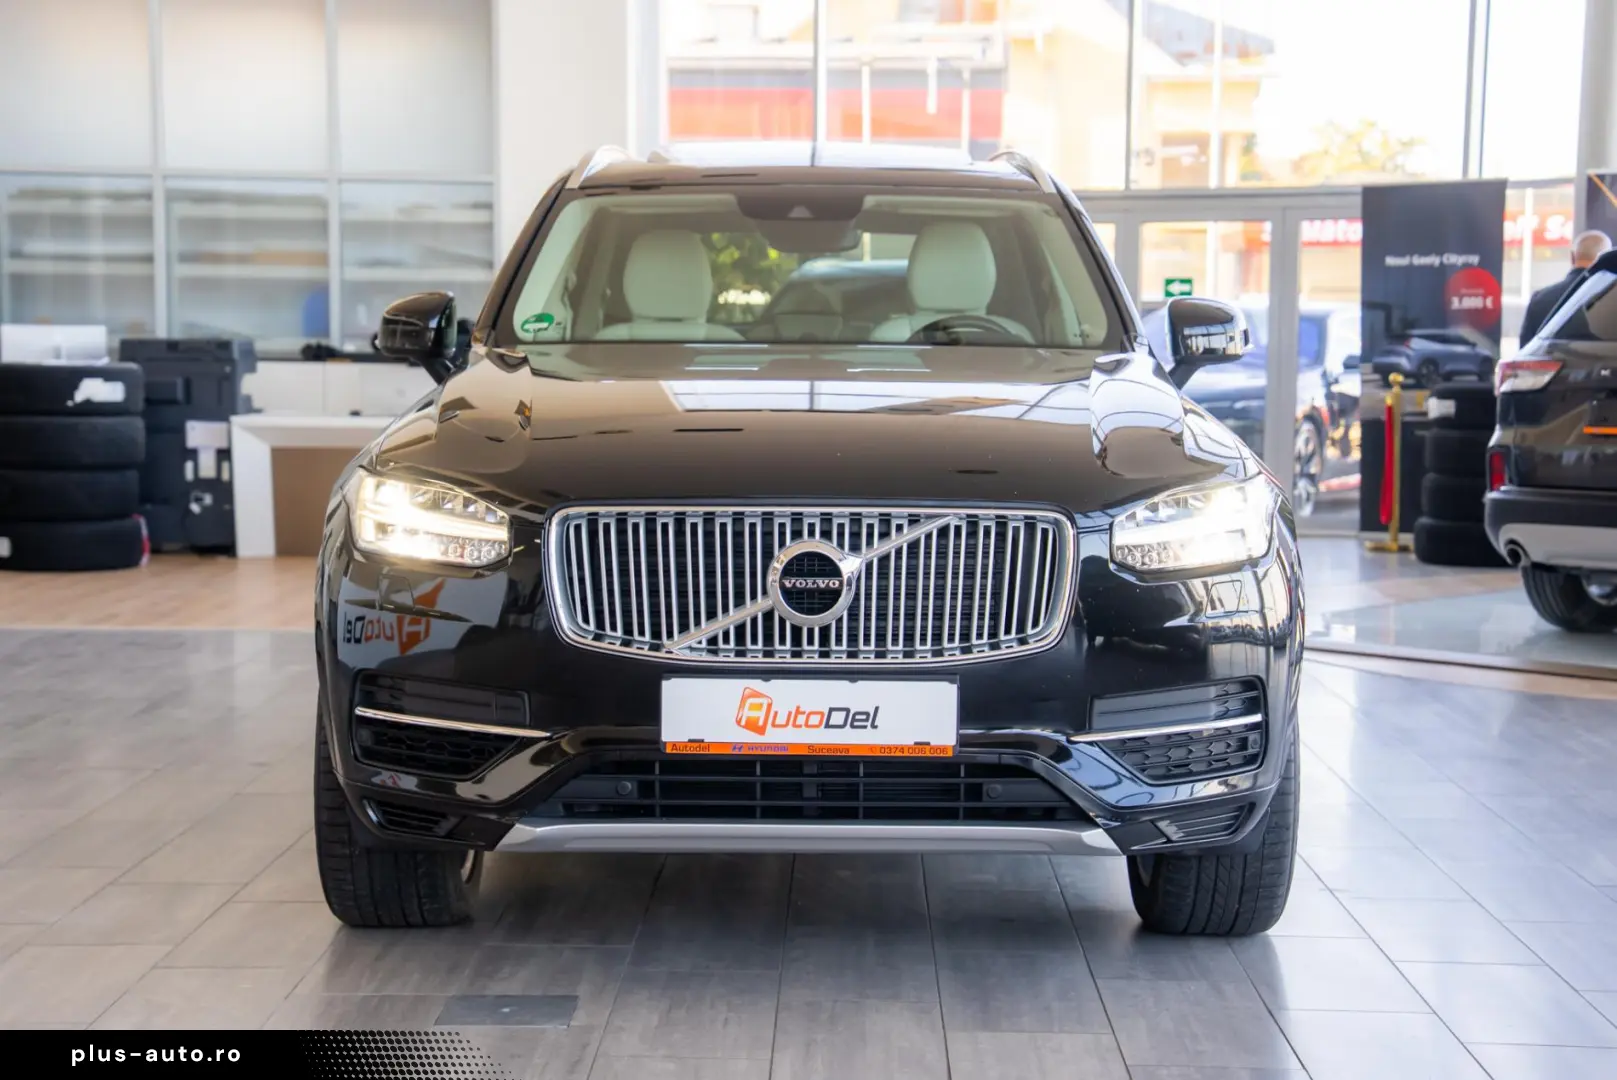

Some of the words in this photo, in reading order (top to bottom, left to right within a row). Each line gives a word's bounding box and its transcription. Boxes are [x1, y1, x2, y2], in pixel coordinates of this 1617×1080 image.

[782, 579, 840, 588] VOLVO
[735, 687, 880, 736] AutoDel
[671, 743, 710, 753] Autodel
[807, 745, 850, 755] Suceava
[879, 745, 905, 755] 0374
[907, 746, 927, 755] 006
[929, 746, 949, 756] 006
